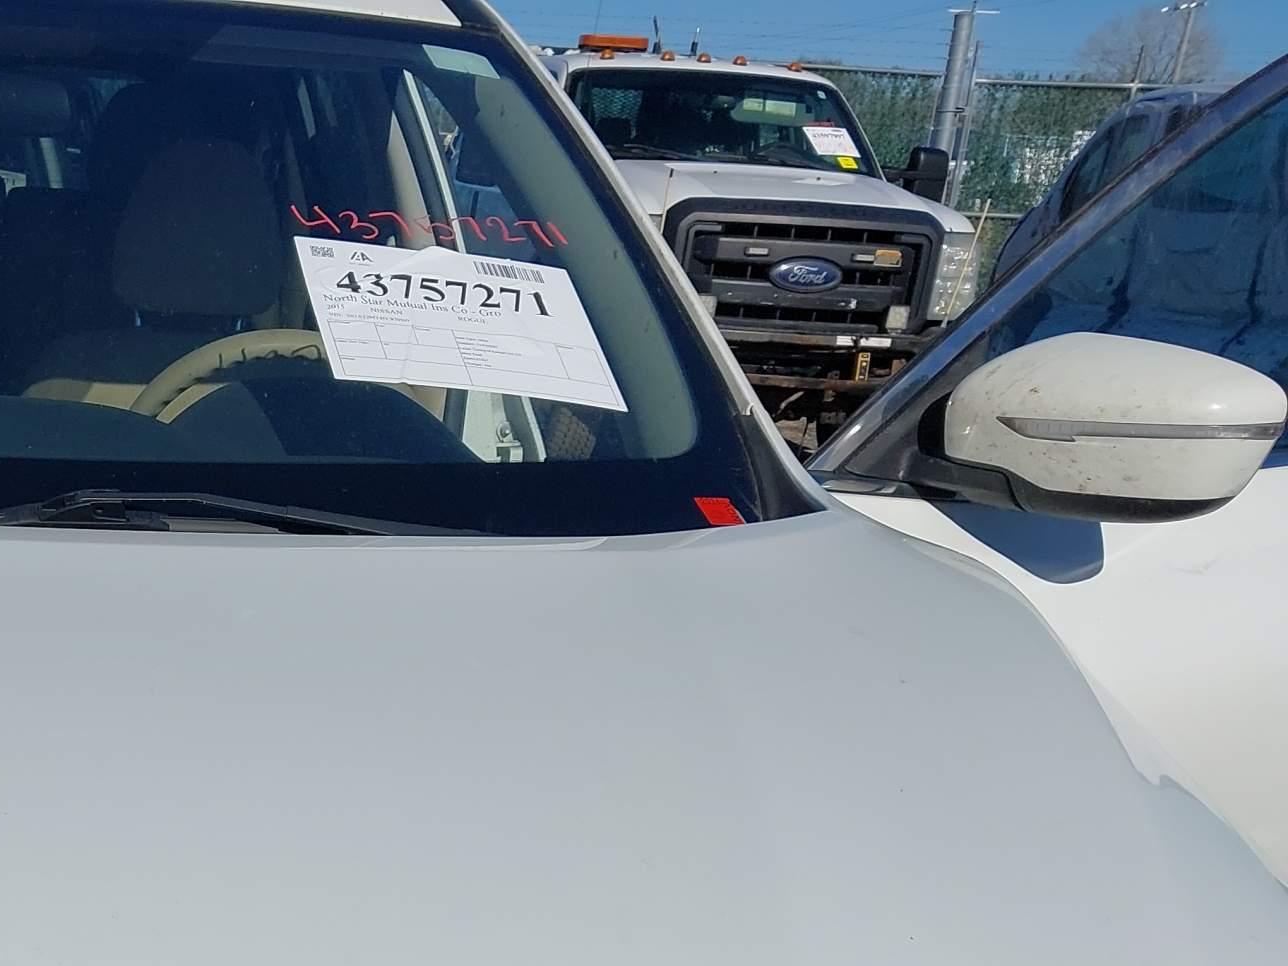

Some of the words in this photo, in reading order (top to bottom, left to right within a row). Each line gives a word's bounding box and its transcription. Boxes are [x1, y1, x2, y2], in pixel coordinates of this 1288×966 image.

[291, 205, 568, 247] 43757271
[788, 265, 828, 284] Ford
[323, 293, 358, 304] North
[360, 295, 383, 306] Star
[386, 299, 427, 311] Mutual
[431, 304, 449, 313] Ins
[451, 305, 468, 315] Co
[336, 271, 555, 318] 43757271
